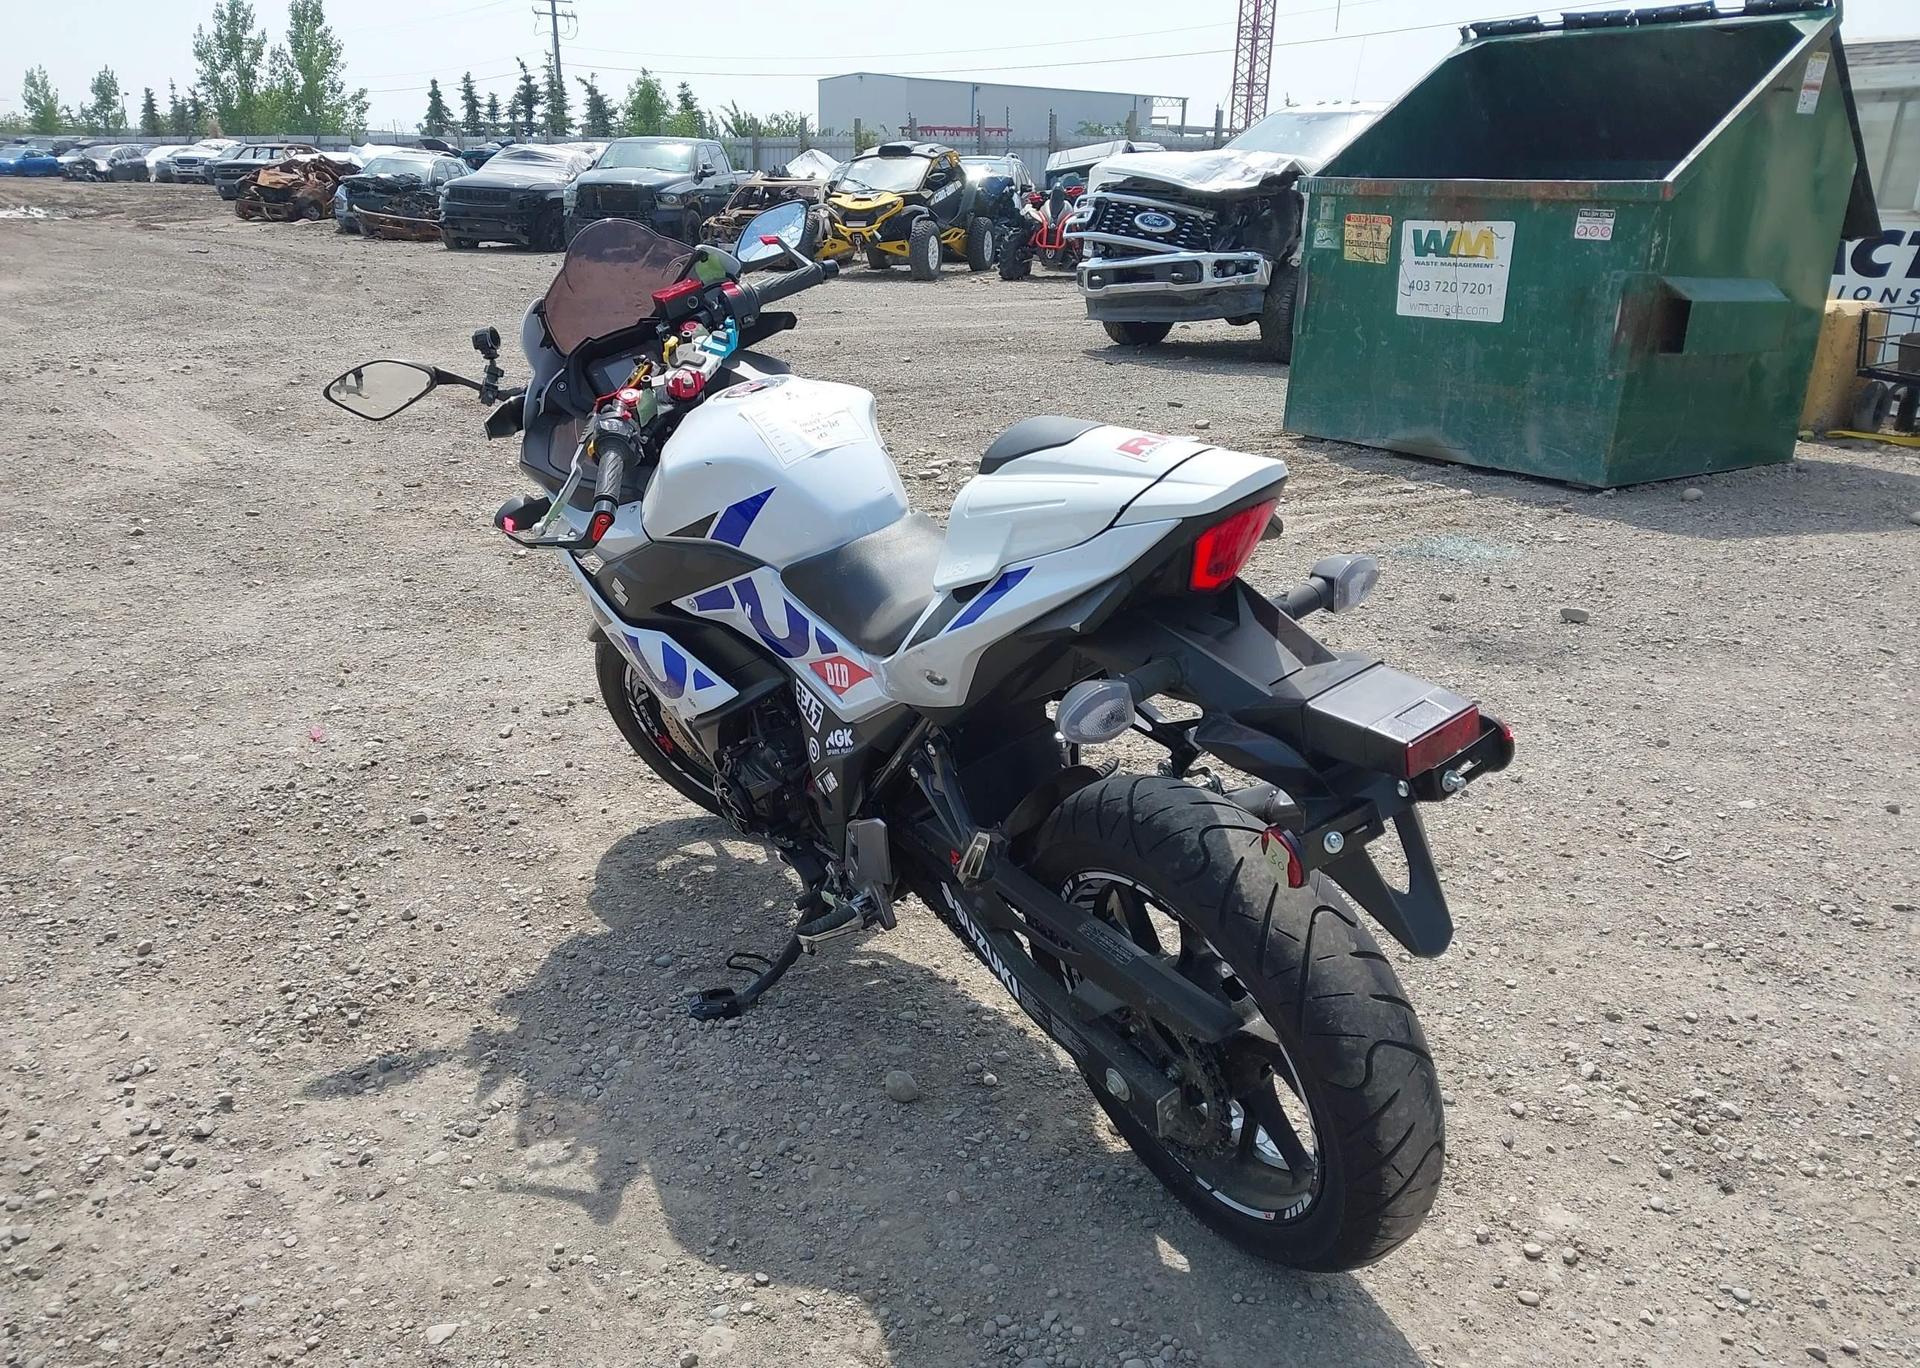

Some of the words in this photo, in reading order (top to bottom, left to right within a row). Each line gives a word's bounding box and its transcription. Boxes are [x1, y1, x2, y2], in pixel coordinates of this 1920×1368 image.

[1144, 215, 1166, 226] Ford
[1412, 228, 1495, 259] WM
[1440, 261, 1495, 269] MANAGEMENT
[1409, 280, 1430, 291] 403
[1435, 281, 1458, 293] 720
[1461, 282, 1494, 295] 7201
[1409, 302, 1490, 316] wmcanada.com
[825, 728, 854, 748] NGK
[953, 898, 1021, 1001] SUZUKI
